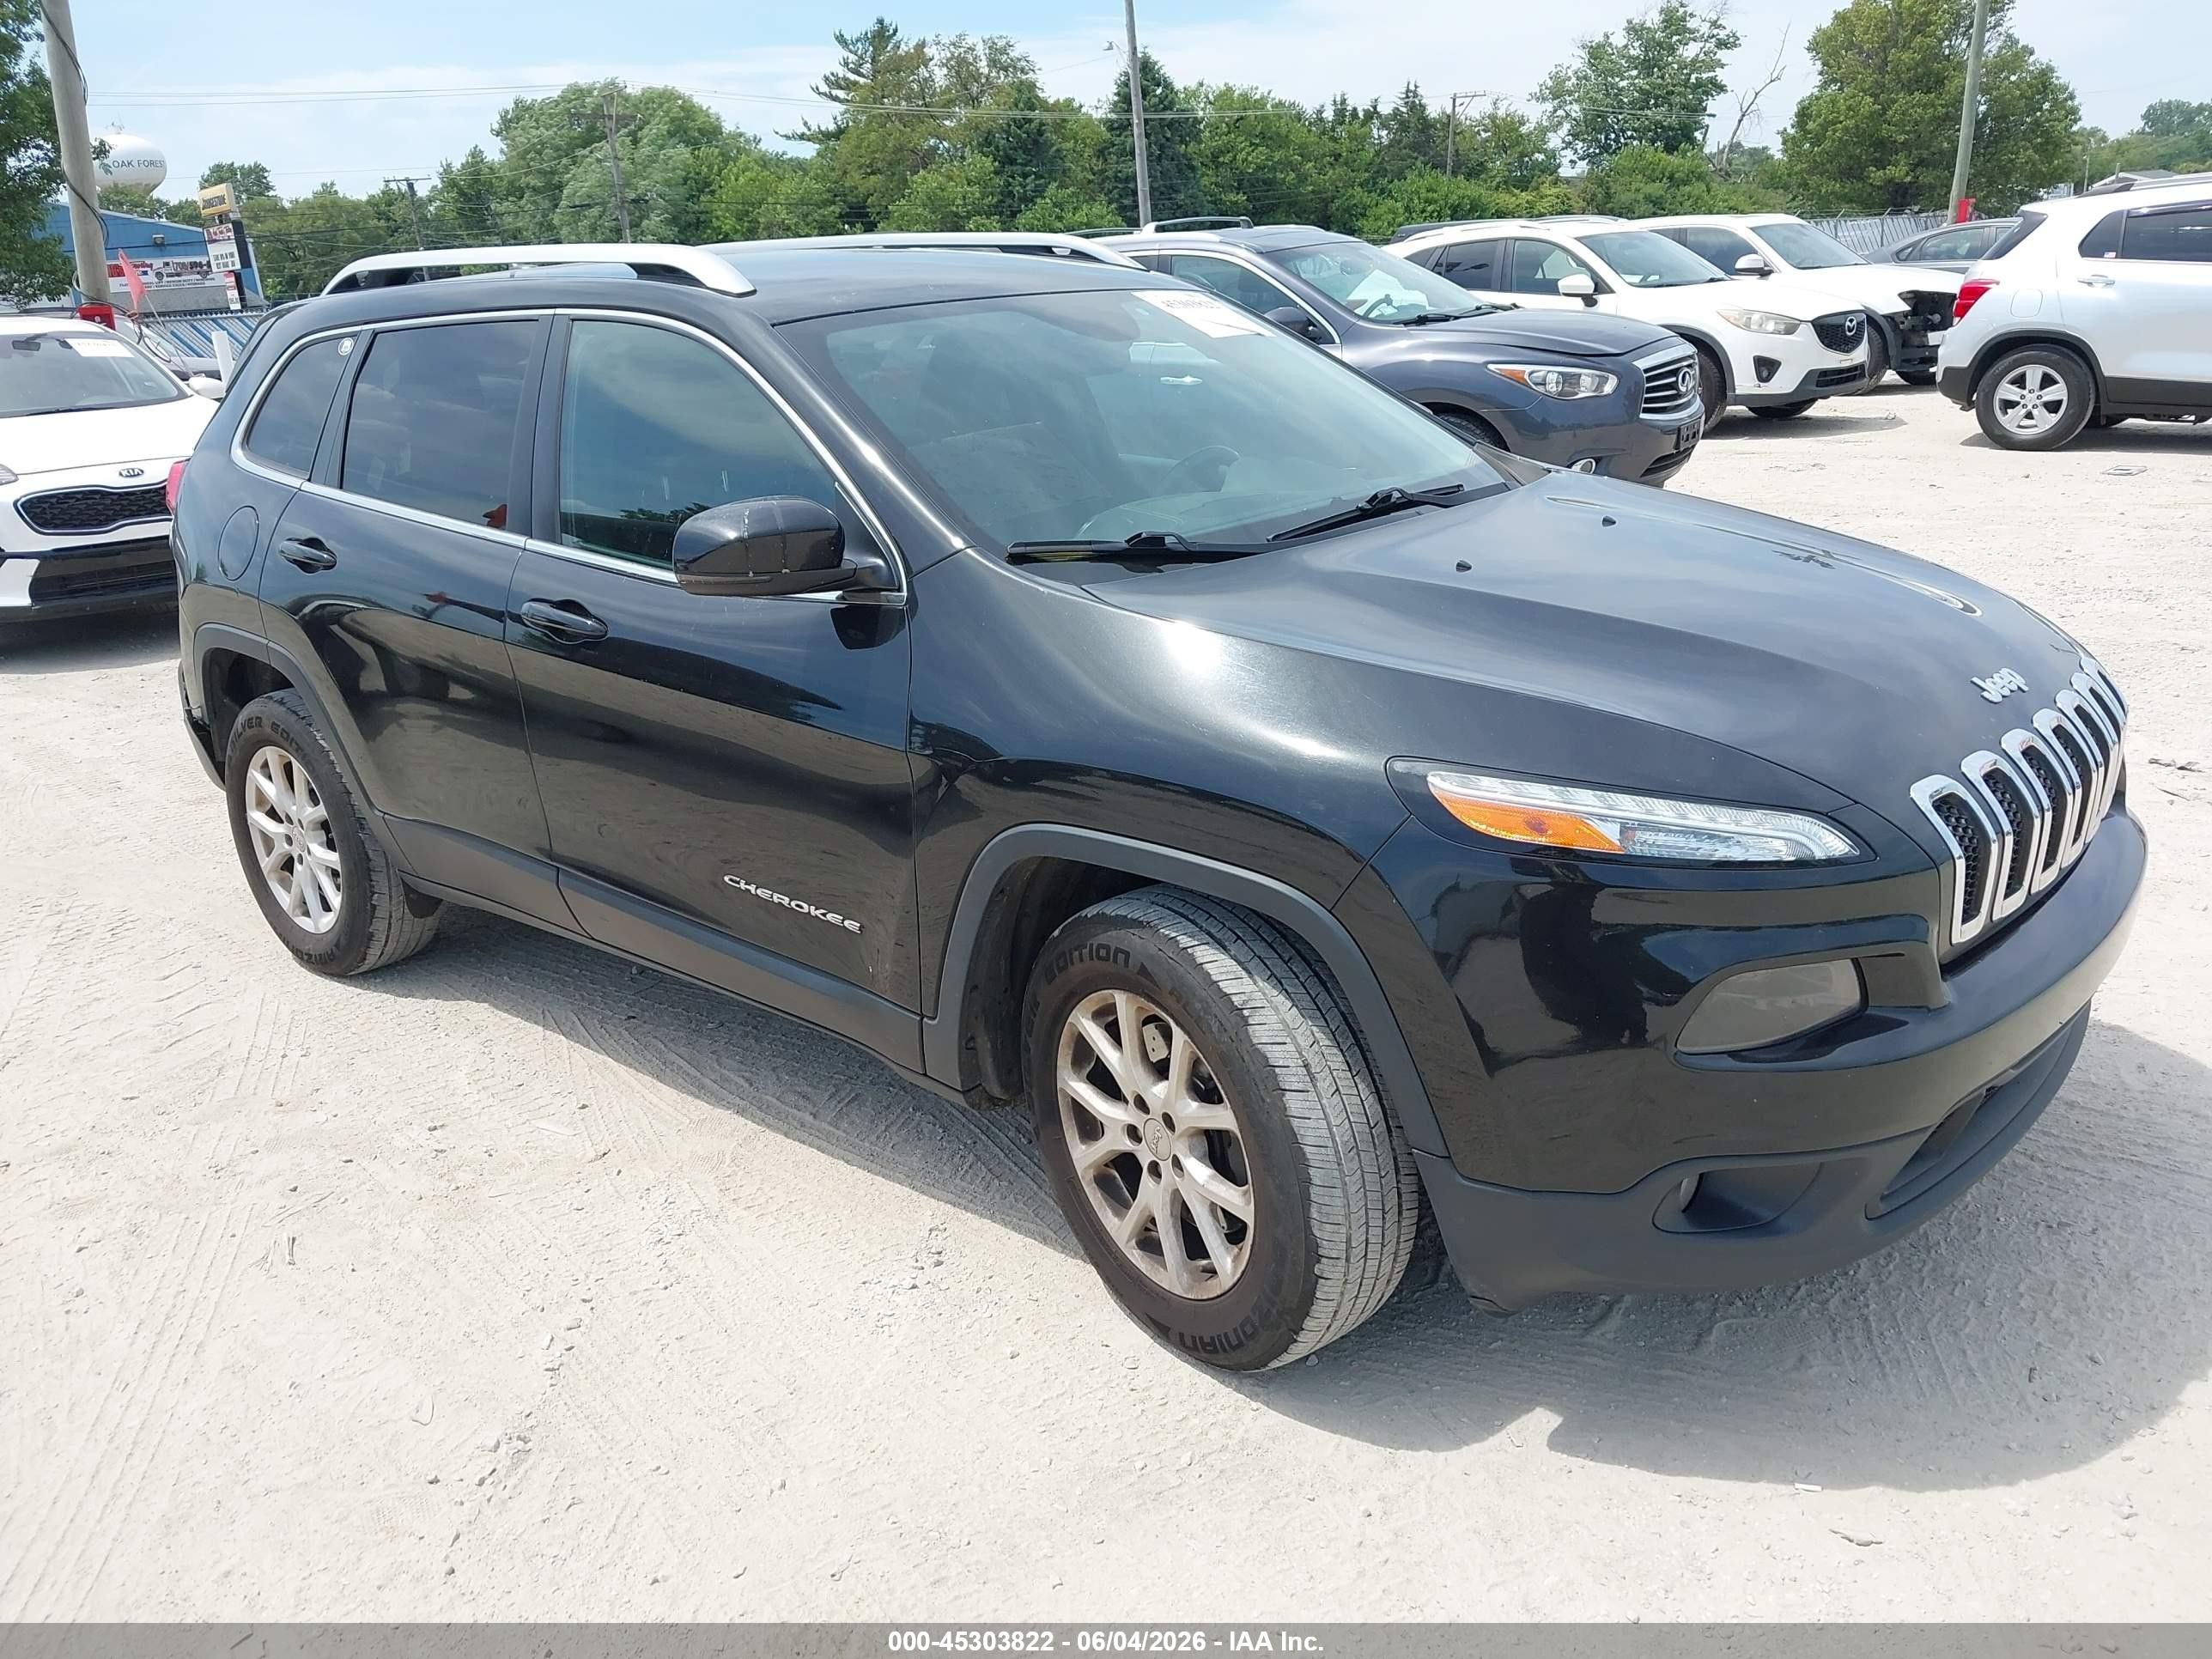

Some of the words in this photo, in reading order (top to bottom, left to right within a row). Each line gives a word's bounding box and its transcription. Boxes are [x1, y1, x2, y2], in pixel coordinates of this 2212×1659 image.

[112, 159, 135, 168] OAK
[120, 468, 143, 477] KIA
[1970, 668, 2028, 704] Jeep
[723, 873, 863, 935] CHEROKEE
